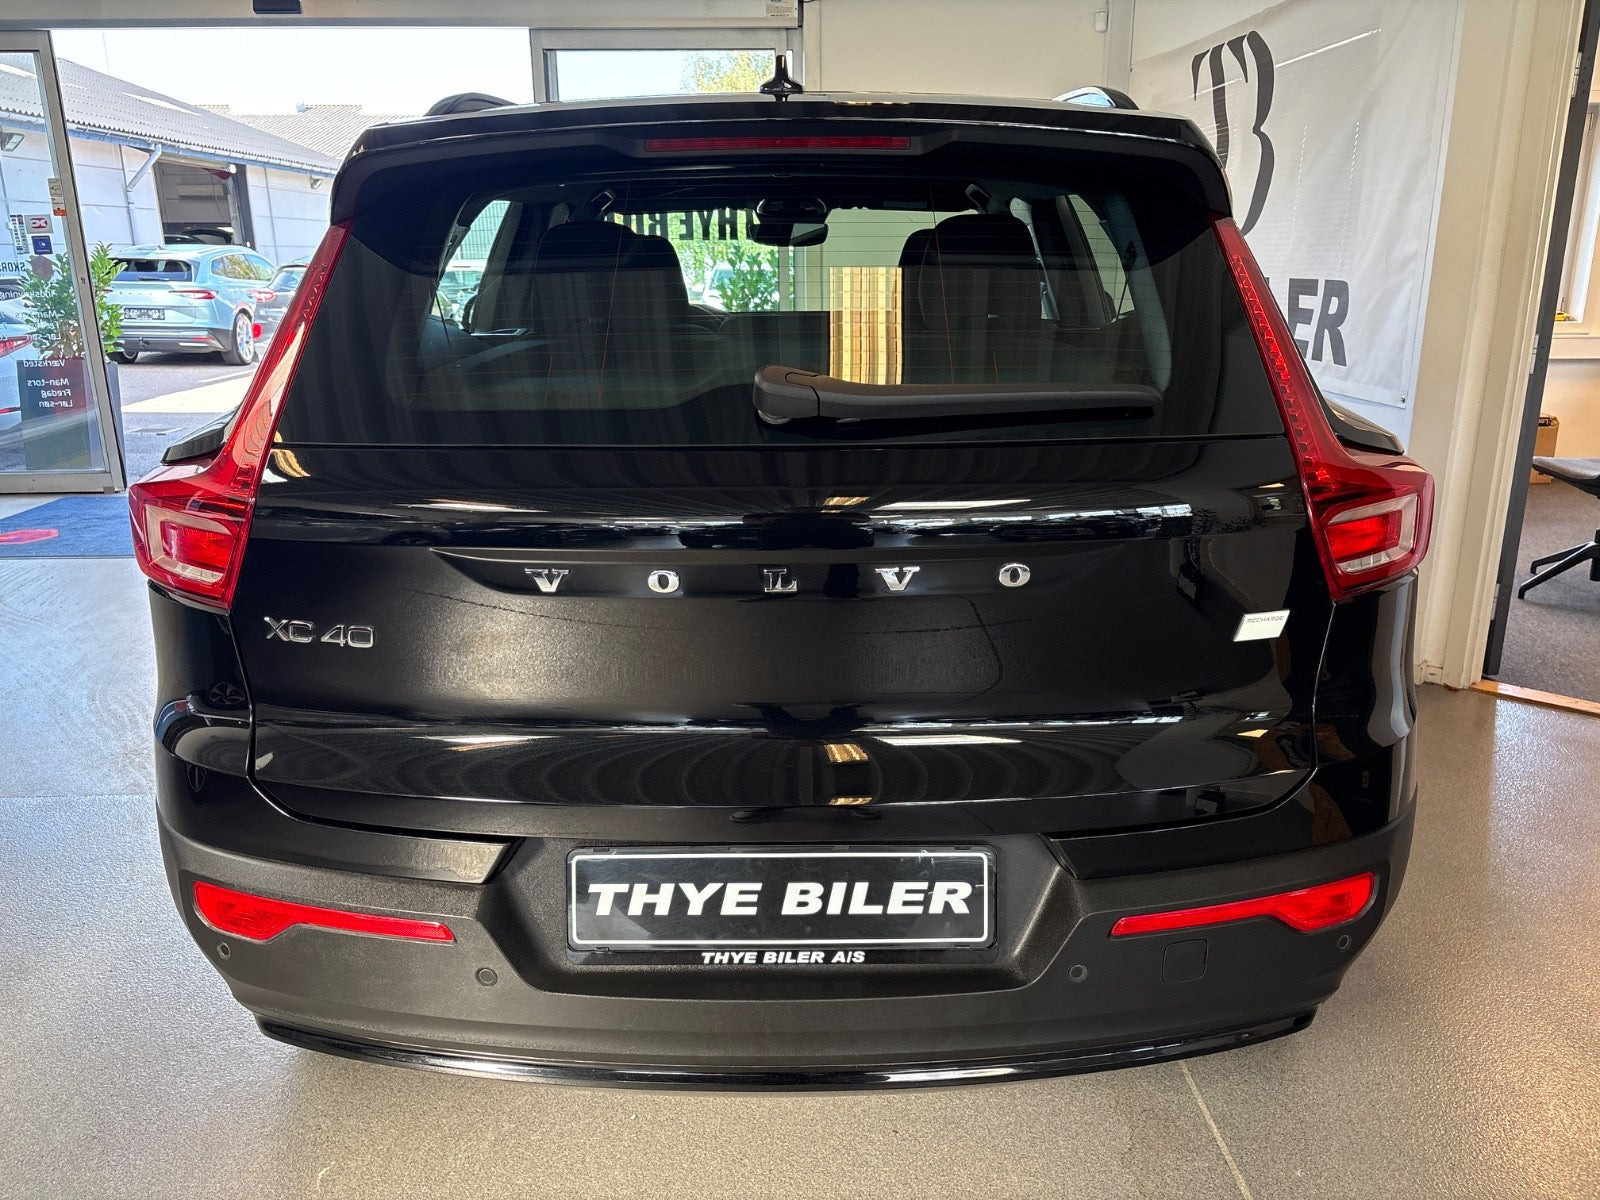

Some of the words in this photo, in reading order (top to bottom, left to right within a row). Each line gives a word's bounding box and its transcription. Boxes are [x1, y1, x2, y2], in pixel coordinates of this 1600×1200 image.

[524, 562, 1032, 594] VOLVO
[587, 882, 763, 916] THYE
[781, 881, 973, 915] BILER
[701, 951, 758, 964] THYE
[762, 951, 825, 964] BILER
